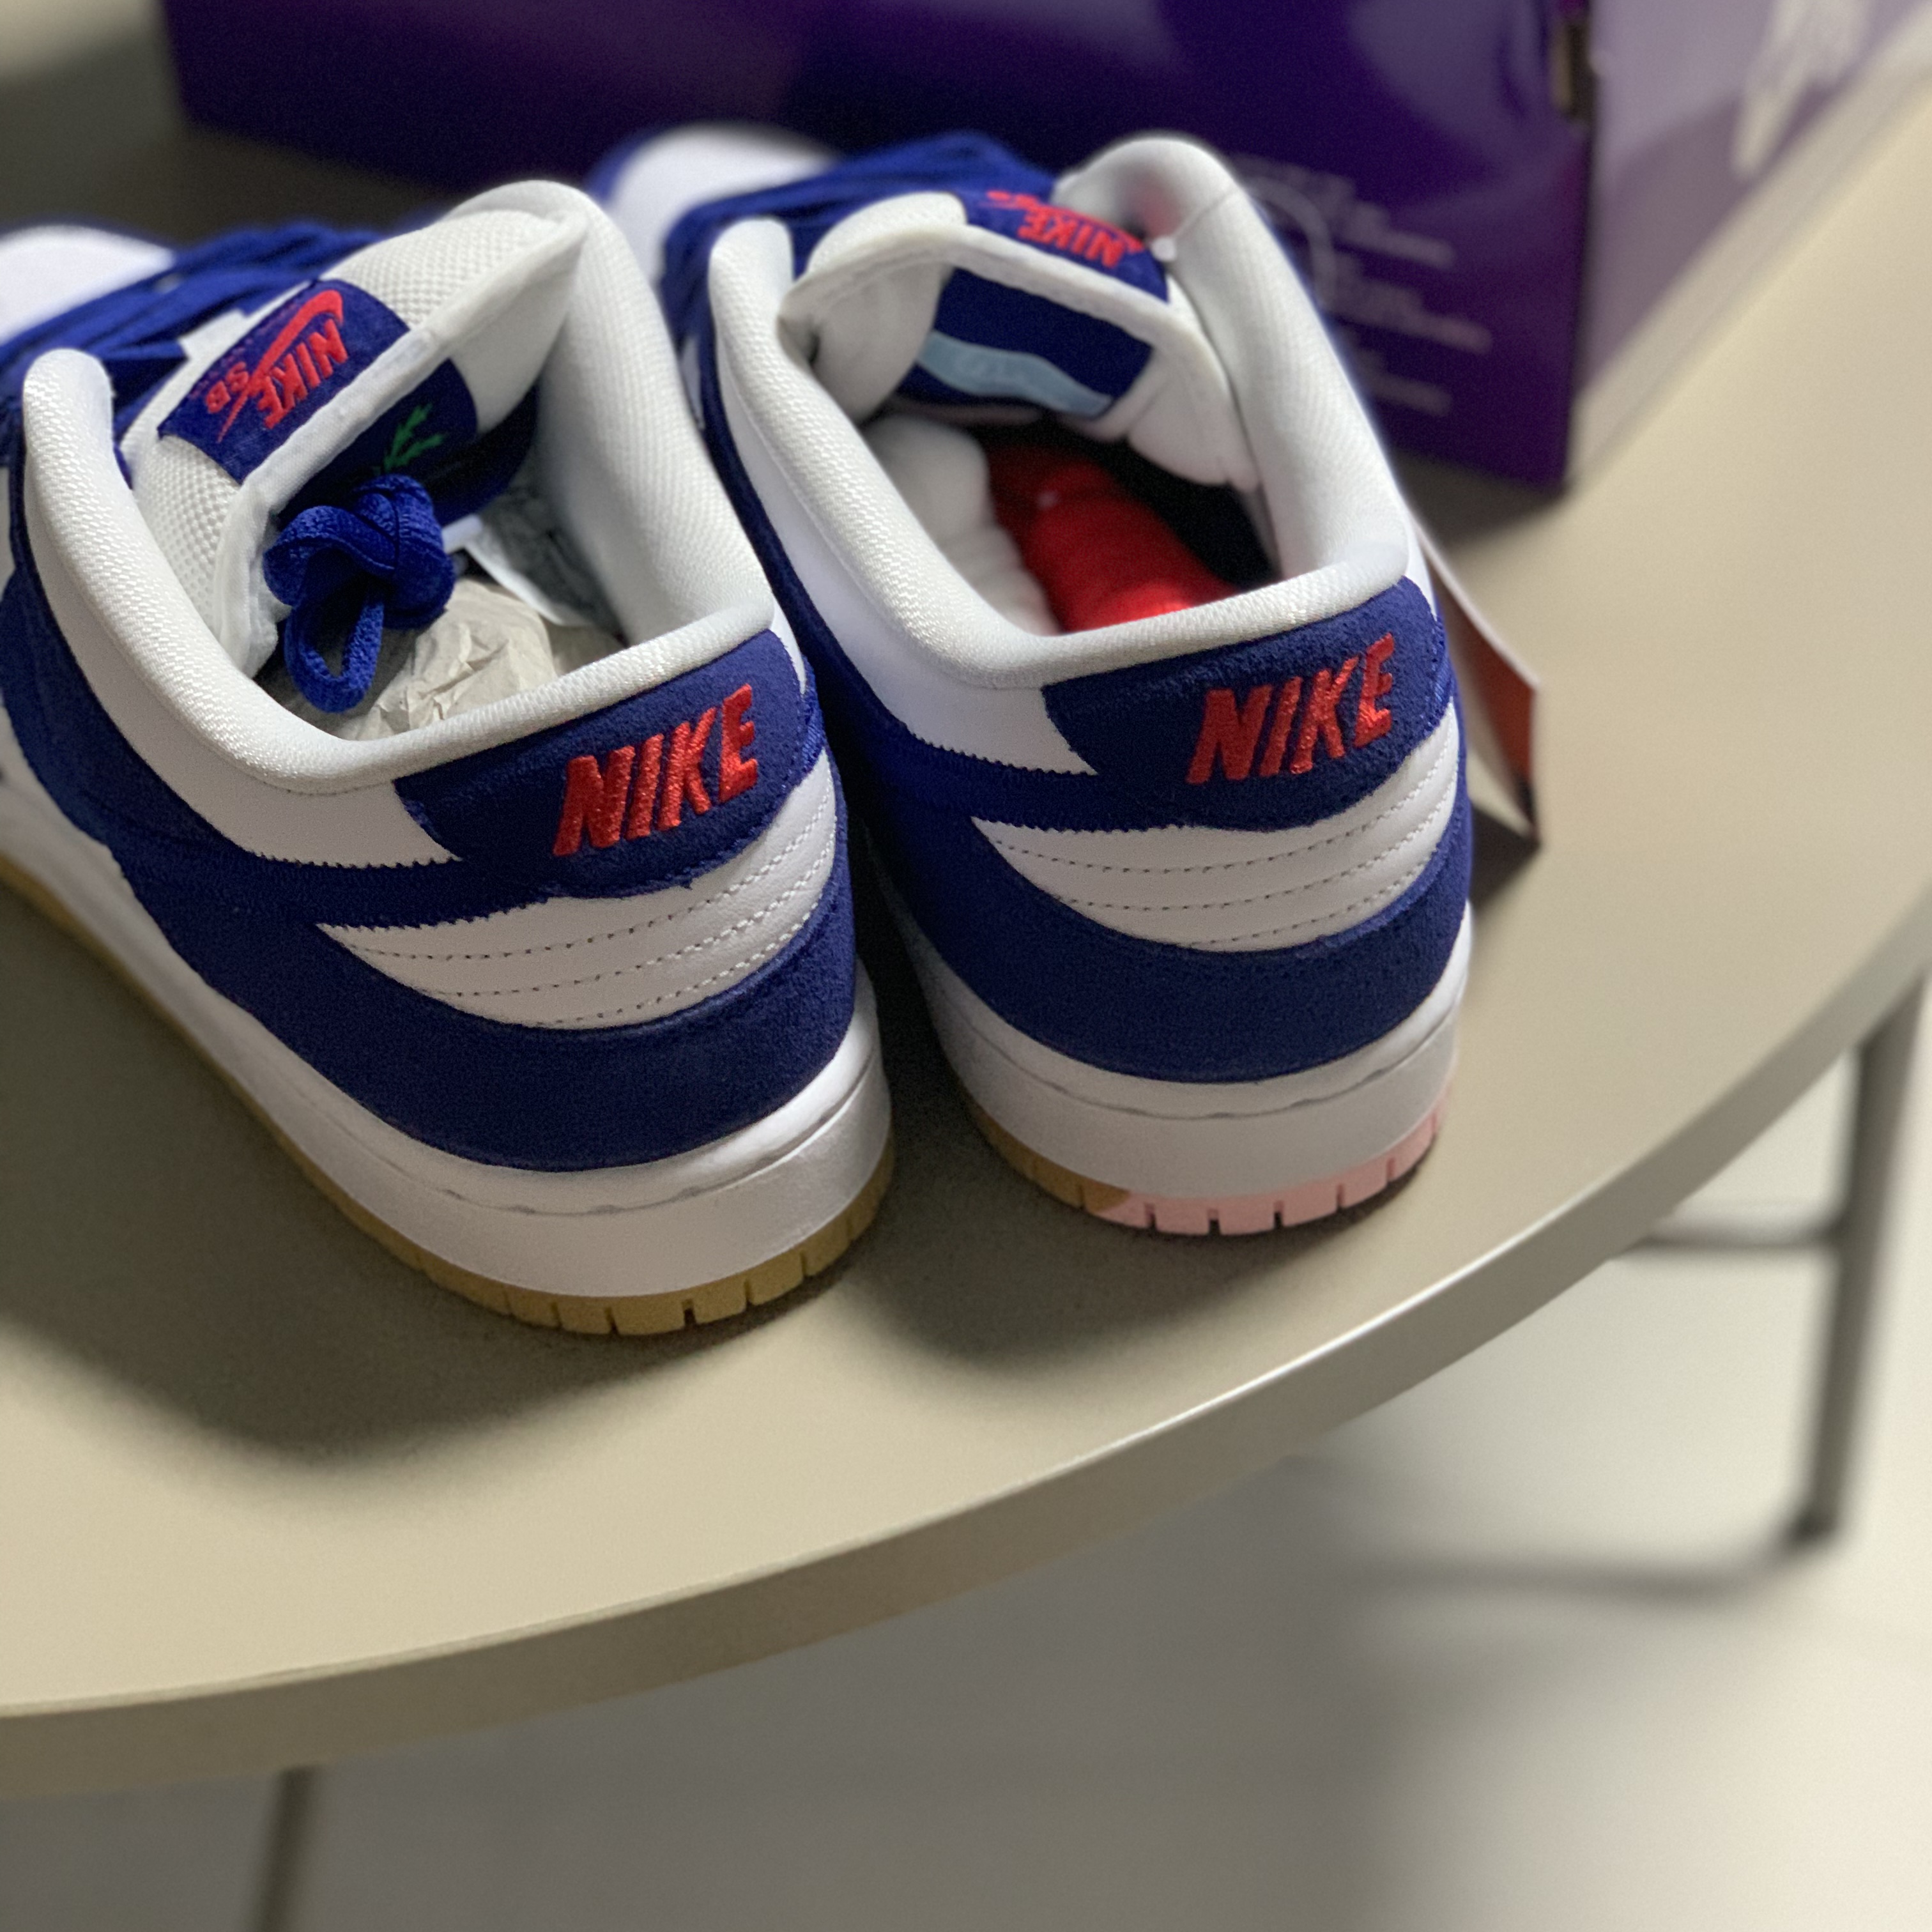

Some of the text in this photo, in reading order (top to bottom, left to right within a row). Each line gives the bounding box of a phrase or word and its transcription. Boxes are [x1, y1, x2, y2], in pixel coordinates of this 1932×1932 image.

[1017, 206, 1124, 268] NIKE
[206, 362, 249, 414] SB
[258, 319, 348, 429] NIKE
[1186, 632, 1395, 785] NIKE
[552, 684, 758, 857] NIKE
